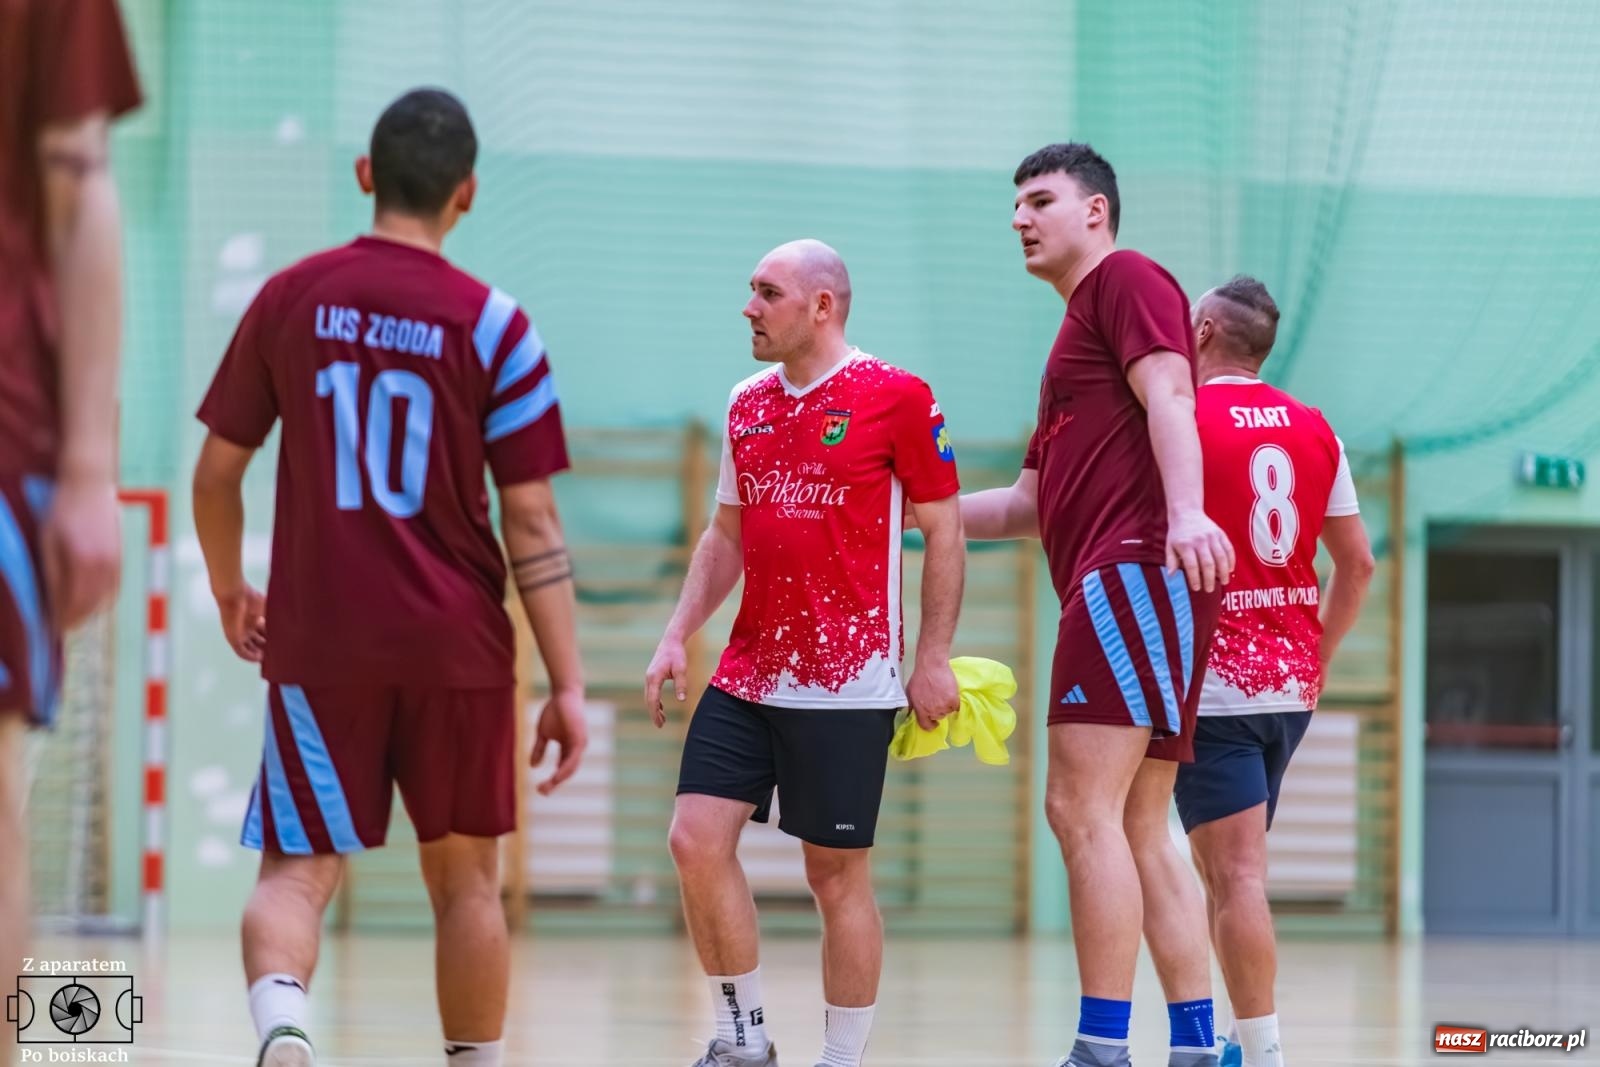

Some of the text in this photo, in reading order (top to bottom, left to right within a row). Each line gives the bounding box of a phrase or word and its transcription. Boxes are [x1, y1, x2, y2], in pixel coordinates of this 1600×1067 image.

[315, 304, 444, 359] LKS ZGODA
[316, 360, 434, 518] 10
[1229, 406, 1291, 428] START
[738, 470, 851, 506] Wiktoria
[1249, 443, 1300, 568] 8
[835, 823, 855, 831] KIPSTA
